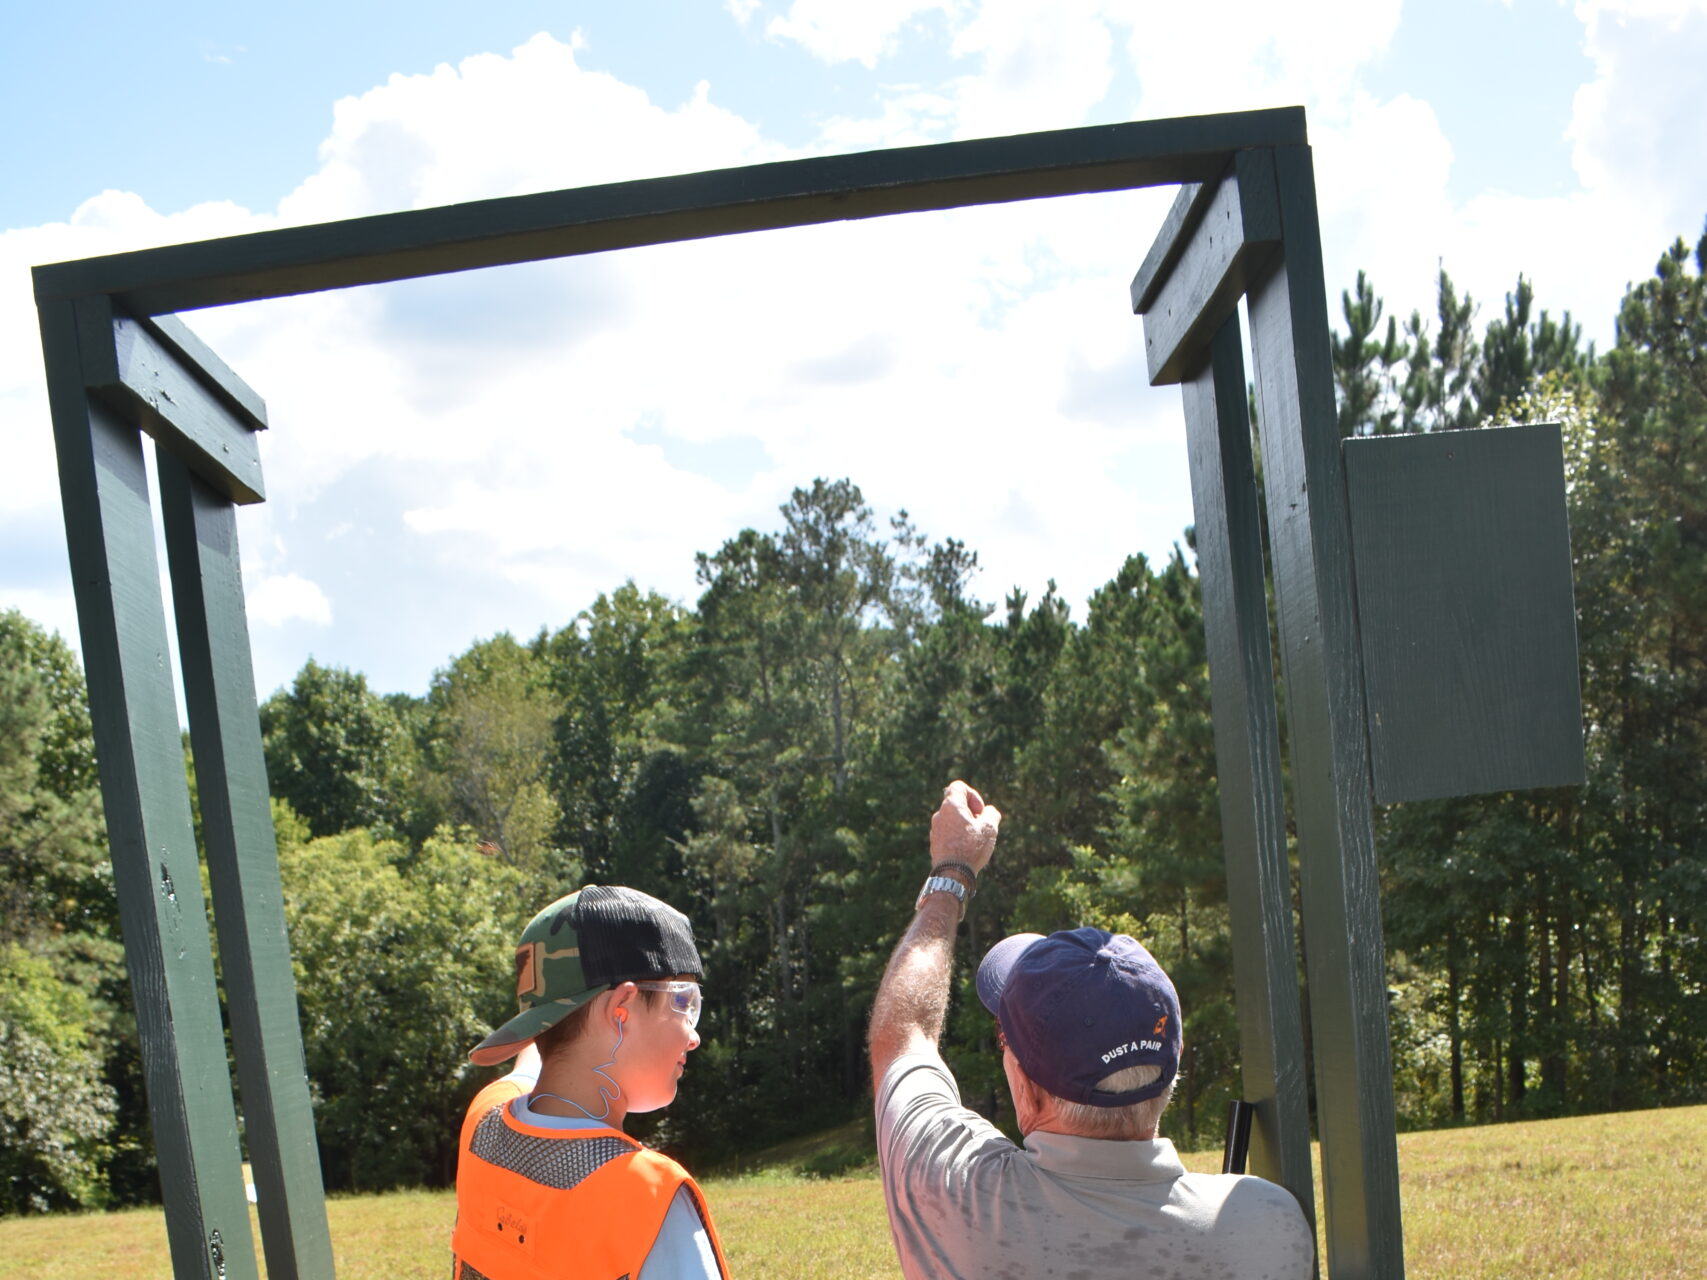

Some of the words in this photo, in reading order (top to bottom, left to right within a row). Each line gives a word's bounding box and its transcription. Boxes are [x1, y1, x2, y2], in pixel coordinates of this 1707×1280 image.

[1101, 1043, 1129, 1064] DUST
[1130, 1041, 1139, 1052] A
[1140, 1039, 1162, 1051] PAIR
